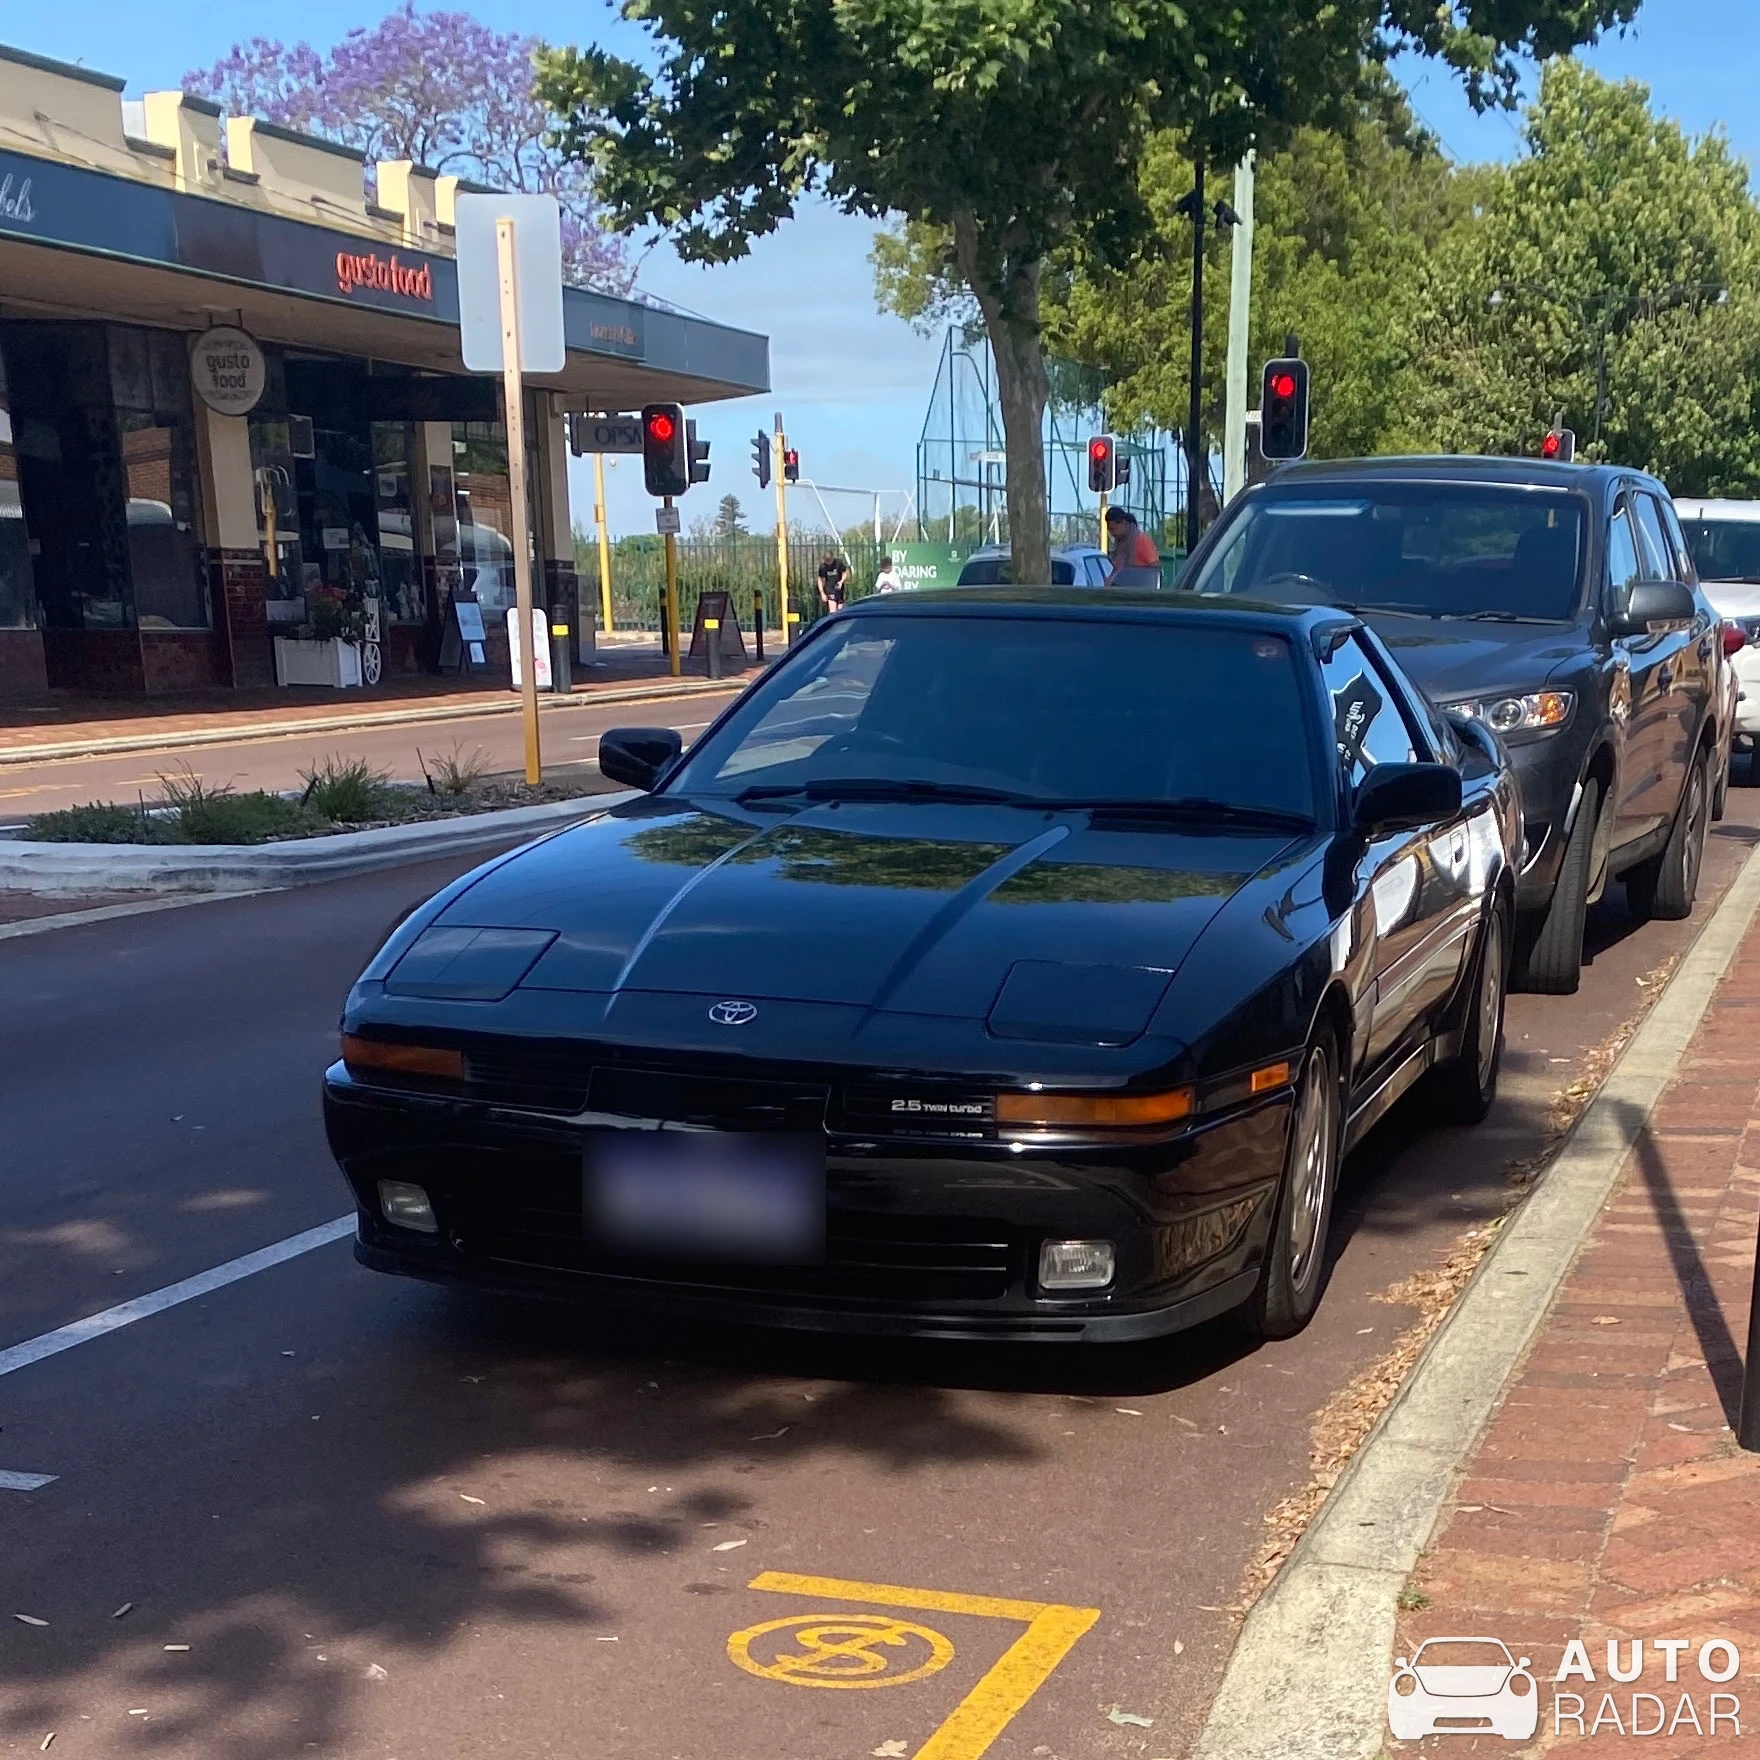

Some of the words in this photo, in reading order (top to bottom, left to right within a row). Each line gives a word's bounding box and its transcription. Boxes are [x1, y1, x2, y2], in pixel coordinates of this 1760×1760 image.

[206, 353, 251, 372] gusto
[212, 372, 247, 388] food
[892, 550, 908, 563] BY
[892, 565, 937, 579] DARING
[891, 1099, 921, 1111] 2.5
